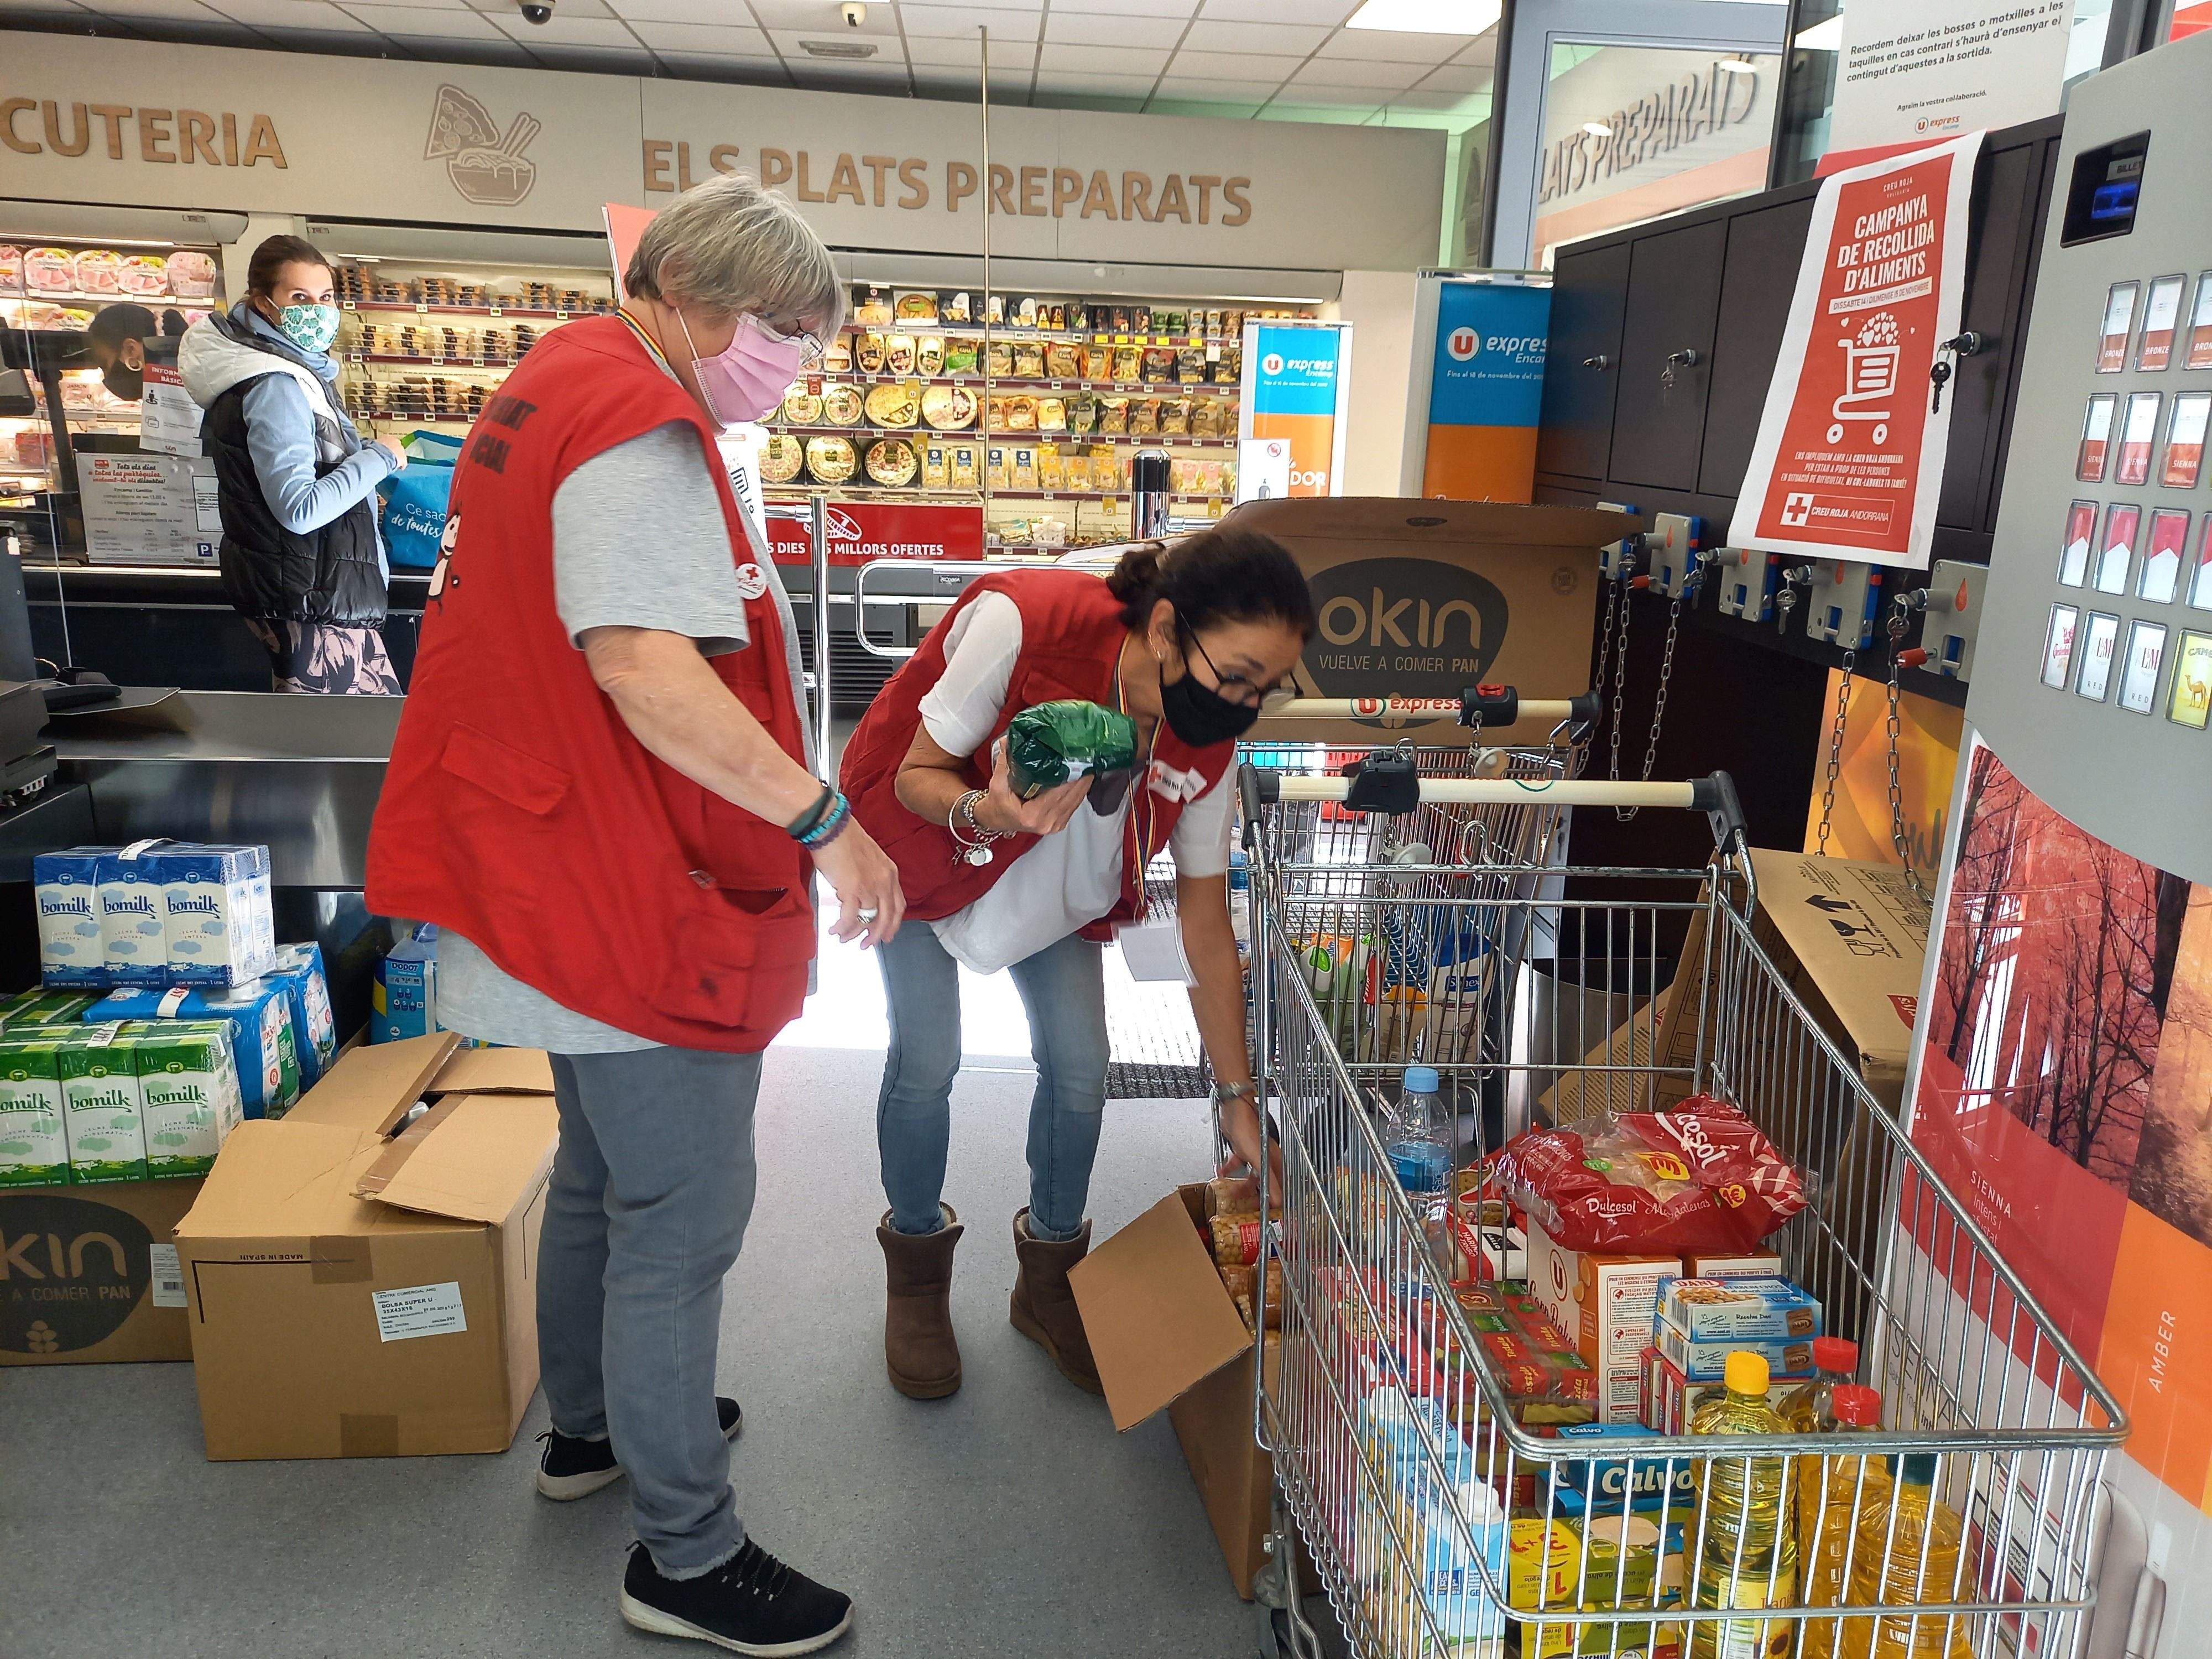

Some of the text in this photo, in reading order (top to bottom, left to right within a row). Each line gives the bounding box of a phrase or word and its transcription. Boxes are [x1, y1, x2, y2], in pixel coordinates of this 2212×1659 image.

[1850, 39, 1893, 55] Recordem
[1897, 32, 1924, 45] deixar
[1928, 29, 1940, 39] les
[1944, 22, 1976, 35] bosses
[1989, 8, 2035, 25] motxilles
[2038, 6, 2045, 14] a
[2049, 1, 2064, 12] les
[1849, 15, 2062, 70] taquilles en cas contrari s'haurà d'ensenyar el
[1846, 67, 1888, 82] contingut
[1890, 58, 1937, 74] d'aquestes
[1946, 54, 1954, 62] la
[1957, 46, 1992, 61] sortida.
[1930, 115, 1960, 128] express
[0, 97, 288, 169] CUTERIA
[643, 139, 1253, 226] ELS PLATS PREPARATS
[1883, 176, 1913, 192] CREU ROJA
[1854, 194, 1928, 239] CAMPANYA
[1837, 220, 1934, 269] DE RECOLLIDA
[1844, 251, 1926, 293] D'ALIMENTS
[1833, 299, 1861, 310] DISSABTE
[1454, 335, 1474, 355] U
[2145, 345, 2170, 356] BRONZE
[1268, 359, 1334, 373] U express
[2127, 457, 2148, 466] SIENNA
[2172, 460, 2197, 468] SIENNA
[405, 503, 422, 517] Ce
[1811, 507, 1889, 522] CREU ROJA ANDORRANA
[391, 513, 443, 538] de toutes
[777, 541, 944, 556] DIES MILLORS OFERTES
[1319, 655, 1479, 673] VUELVE A COMER PAN
[2088, 681, 2102, 691] RED
[1390, 698, 1463, 714] express
[2131, 693, 2149, 703] RED
[40, 896, 94, 914] bomilk
[102, 895, 156, 913] bomilk
[167, 895, 221, 913] bomilk
[390, 962, 418, 972] DODOT
[1449, 977, 1479, 987] Snex
[69, 1089, 132, 1109] bomilk
[147, 1084, 208, 1104] bomilk
[1722, 1188, 1744, 1204] 1€
[1971, 1170, 2011, 1218] SIENNA
[1585, 1192, 1637, 1215] Dulcesol
[1974, 1194, 1997, 1226] Intens
[1553, 1260, 1563, 1290] U
[32, 1287, 90, 1301] COMER
[99, 1286, 131, 1300] PAN
[2148, 1311, 2176, 1394] AMBER
